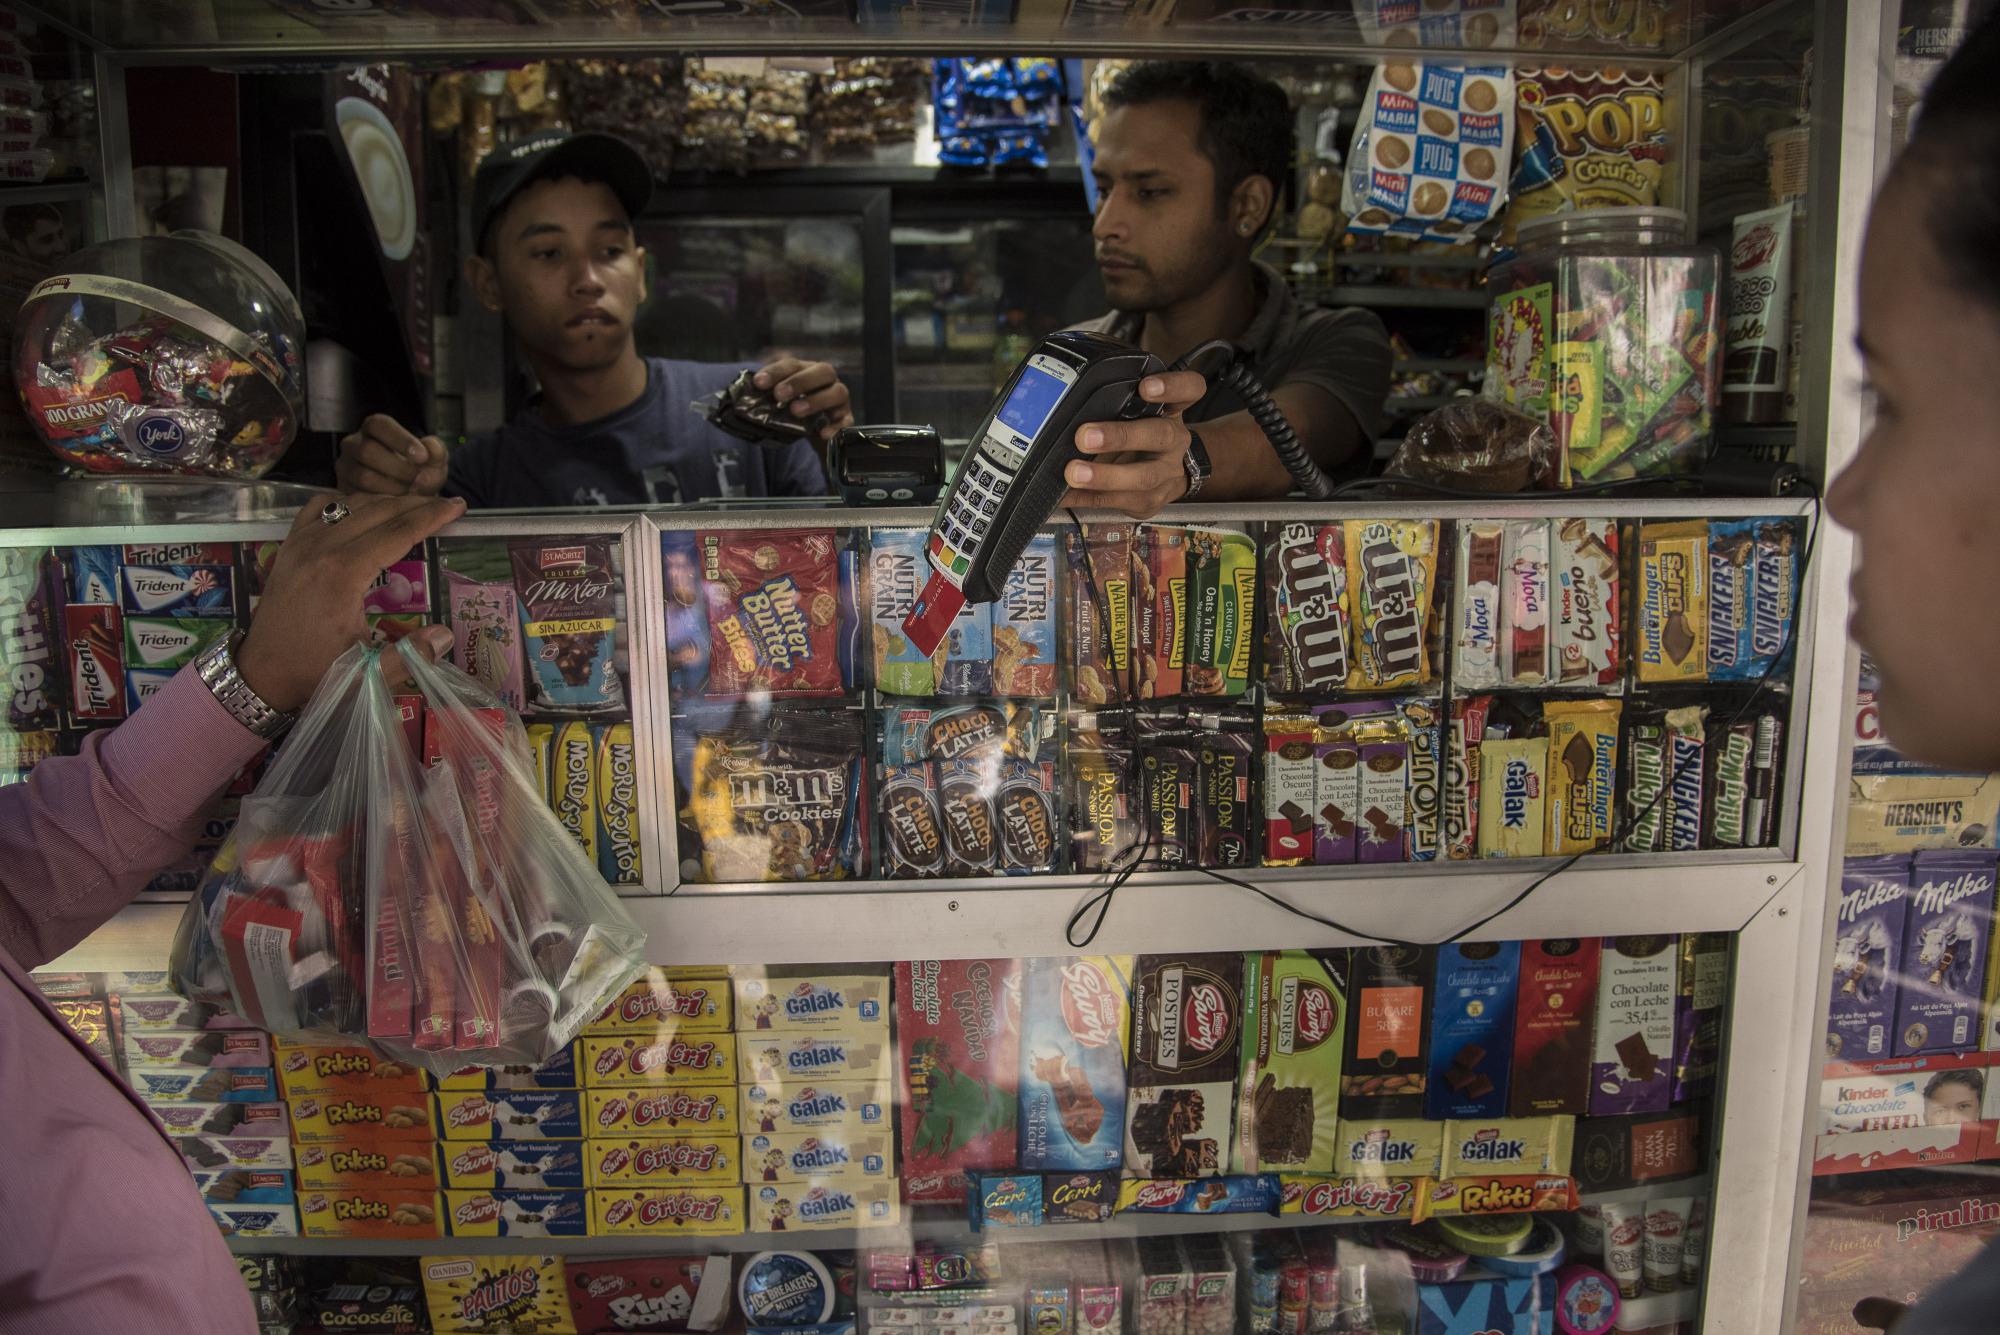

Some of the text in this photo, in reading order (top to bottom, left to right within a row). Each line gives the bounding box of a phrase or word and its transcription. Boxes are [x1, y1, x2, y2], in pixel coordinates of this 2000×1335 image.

[1380, 93, 1417, 111] Mini
[1426, 73, 1456, 103] PUIG
[1377, 110, 1417, 126] MARIA
[1461, 126, 1500, 140] MARIA
[1462, 115, 1499, 129] Mini
[1542, 95, 1664, 153] POP
[1420, 144, 1453, 172] PUIG
[1375, 172, 1408, 192] Mini
[1575, 158, 1648, 190] Cotufas
[1456, 184, 1491, 204] Mini
[145, 427, 178, 447] York
[129, 543, 201, 567] Trident
[134, 578, 187, 592] Trident
[544, 568, 586, 579] FRUTOS
[875, 552, 898, 622] GRAIN
[1025, 556, 1048, 622] NUTRI
[1667, 554, 1684, 613] CUPS
[1081, 600, 1091, 624] Fruit
[1162, 596, 1171, 617] SWEET
[1173, 582, 1186, 627] NATURE
[1205, 586, 1216, 612] Oats
[1571, 565, 1597, 642] bueno
[1641, 561, 1665, 665] Butterfinger
[1709, 555, 1734, 665] SNICKERS
[538, 620, 603, 635] SIN AZUCAR
[742, 592, 791, 671] Butter
[764, 577, 811, 660] Nutter
[1109, 583, 1127, 667] NATURE VALLEY
[1142, 607, 1152, 645] Almond
[1164, 622, 1172, 641] SALTY
[1224, 600, 1233, 649] CRUNCHY
[1230, 573, 1256, 678] NATURE VALLEY
[1471, 598, 1489, 641] Moça
[138, 633, 190, 647] Trident
[717, 614, 757, 673] Bites
[1081, 636, 1091, 654] Nut
[1162, 642, 1170, 655] NUT
[1200, 628, 1214, 663] Honey
[73, 638, 110, 715] Trident
[932, 711, 990, 743] CHOCO
[940, 725, 995, 758] LATTE
[1218, 755, 1235, 829] PASSION
[1280, 773, 1313, 781] Chocolate
[1368, 787, 1401, 795] Chocolate
[1595, 733, 1617, 833] Butterfinger
[1099, 772, 1115, 846] PASSION
[1161, 763, 1178, 837] PASSION
[1319, 792, 1336, 800] con
[1363, 793, 1405, 804] con Leche
[1504, 760, 1528, 830] Galak
[1626, 742, 1663, 852] Milky Way
[1672, 738, 1700, 850] SNICKERS
[763, 806, 842, 822] Cookies
[905, 796, 938, 849] CHOCO
[960, 794, 992, 846] CHOCO
[1019, 796, 1049, 850] CHOCO
[1570, 784, 1586, 841] CUPS
[1884, 801, 1963, 826] HERSHEY'S
[888, 803, 926, 855] LATTE
[1002, 802, 1037, 855] LATTE
[1840, 880, 1904, 923] Milka
[1913, 872, 1993, 916] Milka
[1614, 967, 1647, 976] Chocolates
[786, 991, 844, 1016] Galak
[912, 977, 924, 1011] leche
[1610, 997, 1670, 1009] con Leche
[1611, 982, 1670, 996] Chocolate
[1061, 963, 1109, 1047] Savoy
[1136, 984, 1146, 1054] Chocolate Oscuro
[1162, 978, 1180, 1059] POSTRES
[1260, 975, 1270, 1057] SABOR VENEZOLANO
[1280, 984, 1295, 1048] POSTRES
[1367, 1005, 1415, 1017] BUCARE
[315, 1053, 371, 1078] Rikiti
[789, 1044, 846, 1068] Galak
[326, 1102, 382, 1126] Rikiti
[450, 1102, 494, 1129] Savoy
[790, 1095, 847, 1120] Galak
[1834, 1098, 1907, 1117] Chocolate
[1027, 1119, 1038, 1153] LECHE
[1037, 1092, 1050, 1159] CHOCOLATE
[331, 1149, 387, 1174] Rikiti
[793, 1146, 850, 1170] Galak
[1352, 1139, 1416, 1162] Galak
[1462, 1138, 1525, 1162] Galak
[1646, 1135, 1655, 1166] GRAN
[1655, 1129, 1665, 1168] SAMAN
[453, 1151, 498, 1178] Savoy
[800, 1194, 856, 1218] Galak
[984, 1189, 1026, 1209] Carré
[1052, 1180, 1102, 1205] Carré
[1461, 1181, 1535, 1212] Rikiti
[334, 1197, 390, 1222] Rikiti
[456, 1201, 501, 1228] Savoy
[462, 1268, 536, 1319] PALITOS
[607, 1284, 691, 1319] Ping
[750, 1271, 819, 1313] ICE BREAKERS
[775, 1295, 804, 1313] MINTS
[320, 1309, 415, 1326] Cocosette
